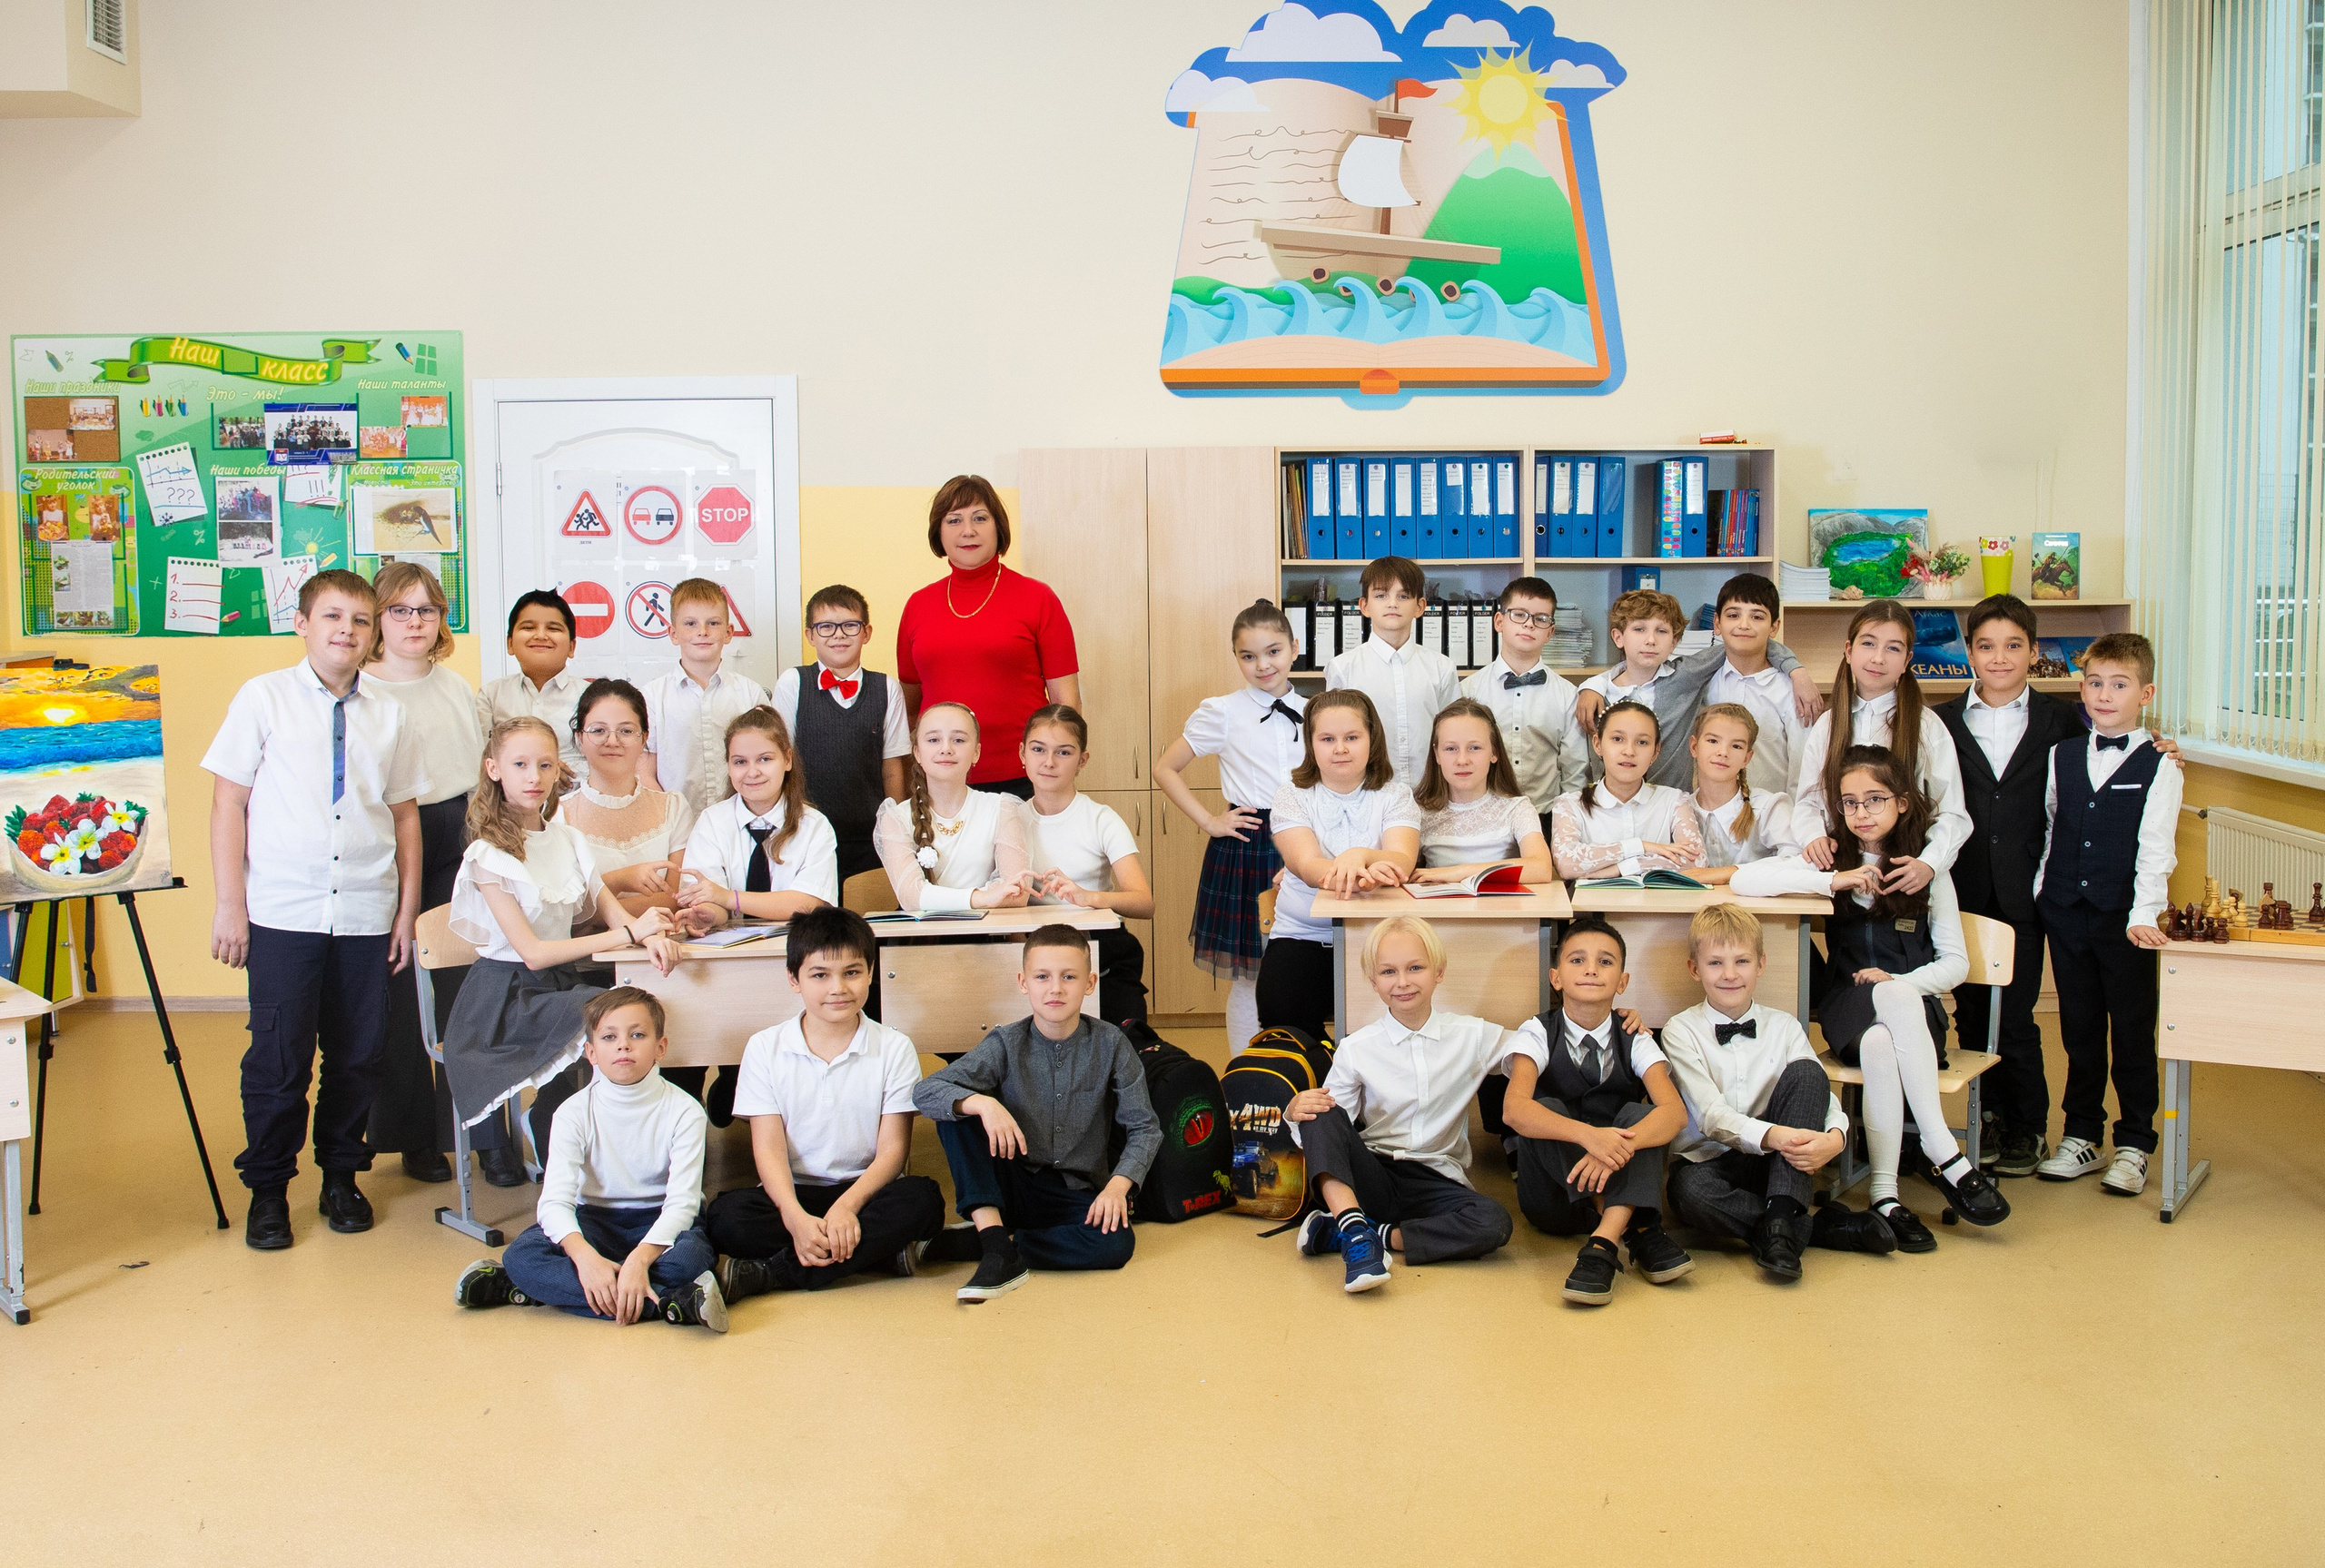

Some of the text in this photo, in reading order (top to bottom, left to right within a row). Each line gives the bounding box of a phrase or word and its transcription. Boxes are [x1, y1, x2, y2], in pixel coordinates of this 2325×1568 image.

[169, 336, 329, 382] Наш класс
[25, 376, 122, 395] Наши праздники
[357, 379, 447, 390] Наши таланты
[206, 386, 237, 400] Это
[252, 386, 285, 400] мы!
[35, 467, 117, 479] Родительский
[210, 463, 286, 476] Наши победы
[351, 463, 459, 477] Классная страничка
[55, 481, 96, 494] уголок
[701, 507, 749, 523] STOP
[170, 573, 179, 584] 1.
[170, 590, 182, 603] 2.
[169, 608, 182, 619] 3.
[1182, 1190, 1222, 1214] T-REX
